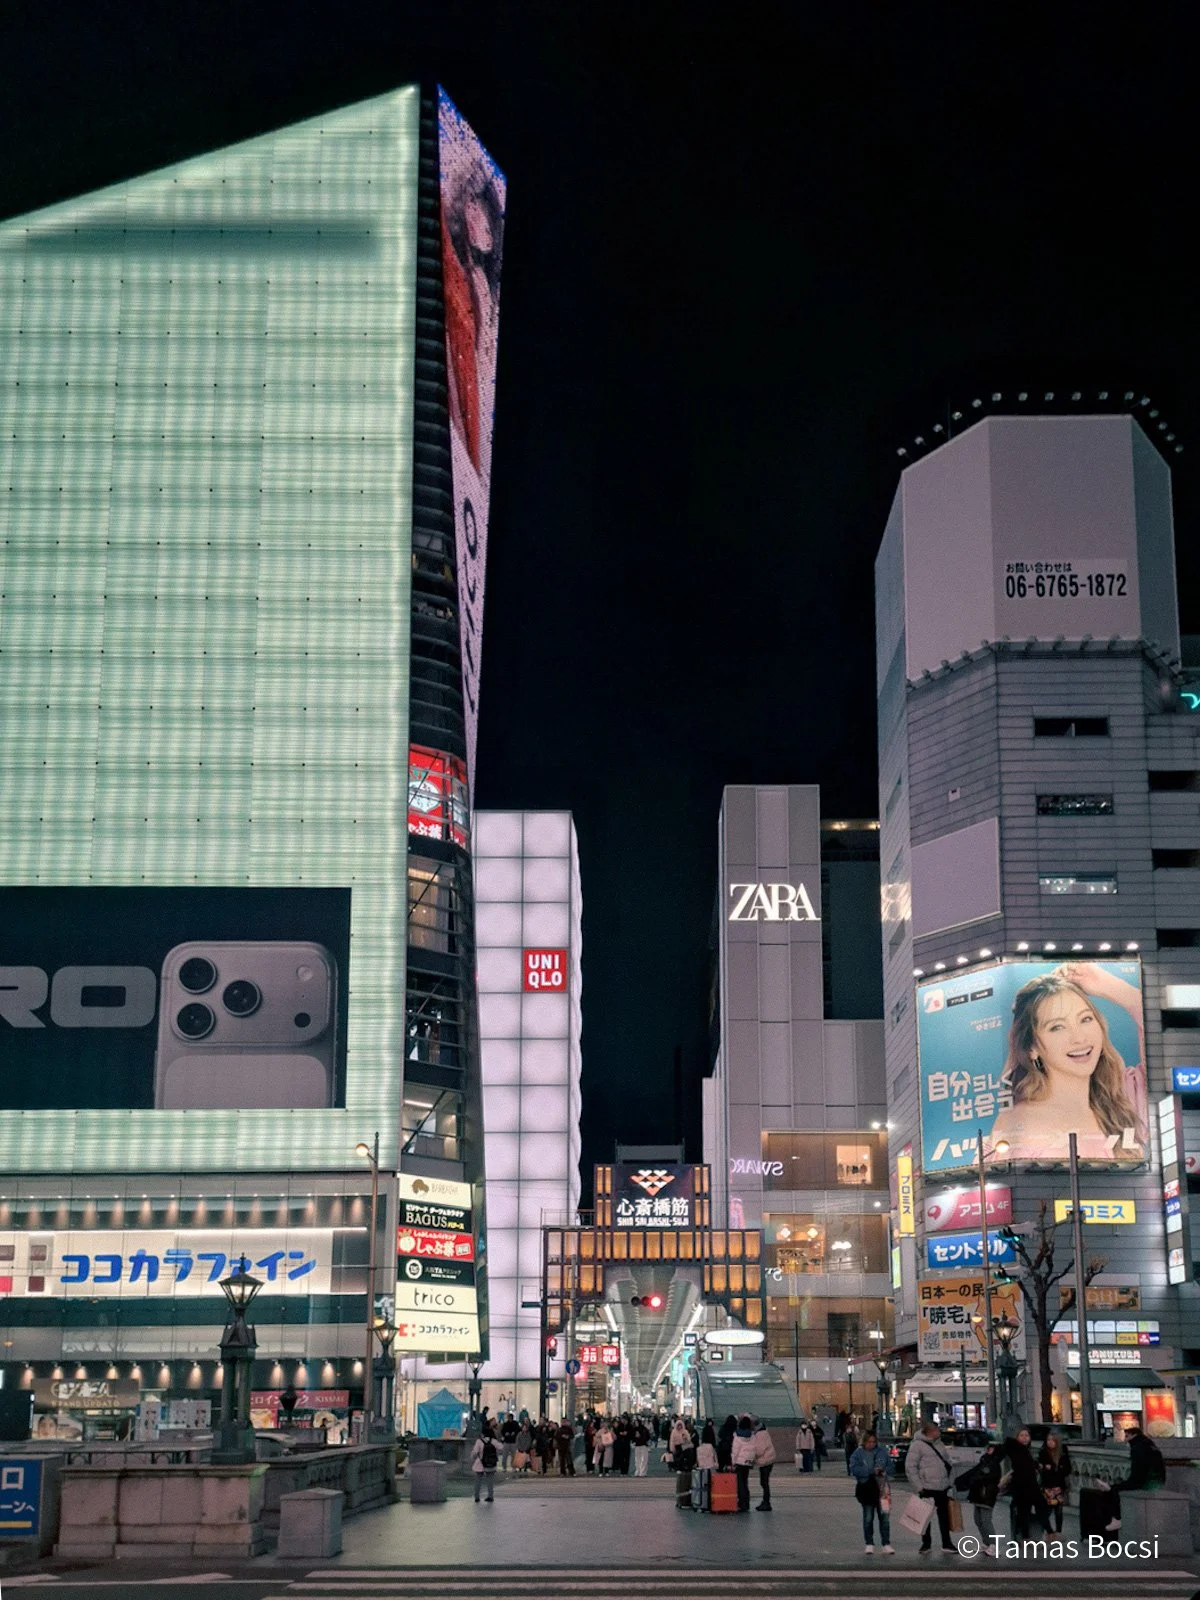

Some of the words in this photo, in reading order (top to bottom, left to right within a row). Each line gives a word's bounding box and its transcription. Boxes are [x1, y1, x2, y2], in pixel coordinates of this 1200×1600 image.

[1006, 562, 1072, 573] お問い合わせは
[1005, 573, 1127, 598] 06-6765-1872
[728, 882, 822, 921] ZARA
[528, 954, 561, 969] UNI
[528, 971, 562, 987] QLO
[928, 1068, 1013, 1102] 自分らしく
[952, 1089, 1014, 1122] 出会う
[901, 1175, 911, 1214] プロミス
[616, 1197, 689, 1217] 心斎橋筋
[959, 1201, 995, 1217] アコム
[1065, 1204, 1125, 1219] ロミス
[405, 1212, 448, 1229] BAGUS
[933, 1239, 1008, 1262] セントラル
[60, 1248, 317, 1284] ココカラファイン
[413, 1287, 455, 1306] trico
[418, 1324, 470, 1335] ココカラファイン
